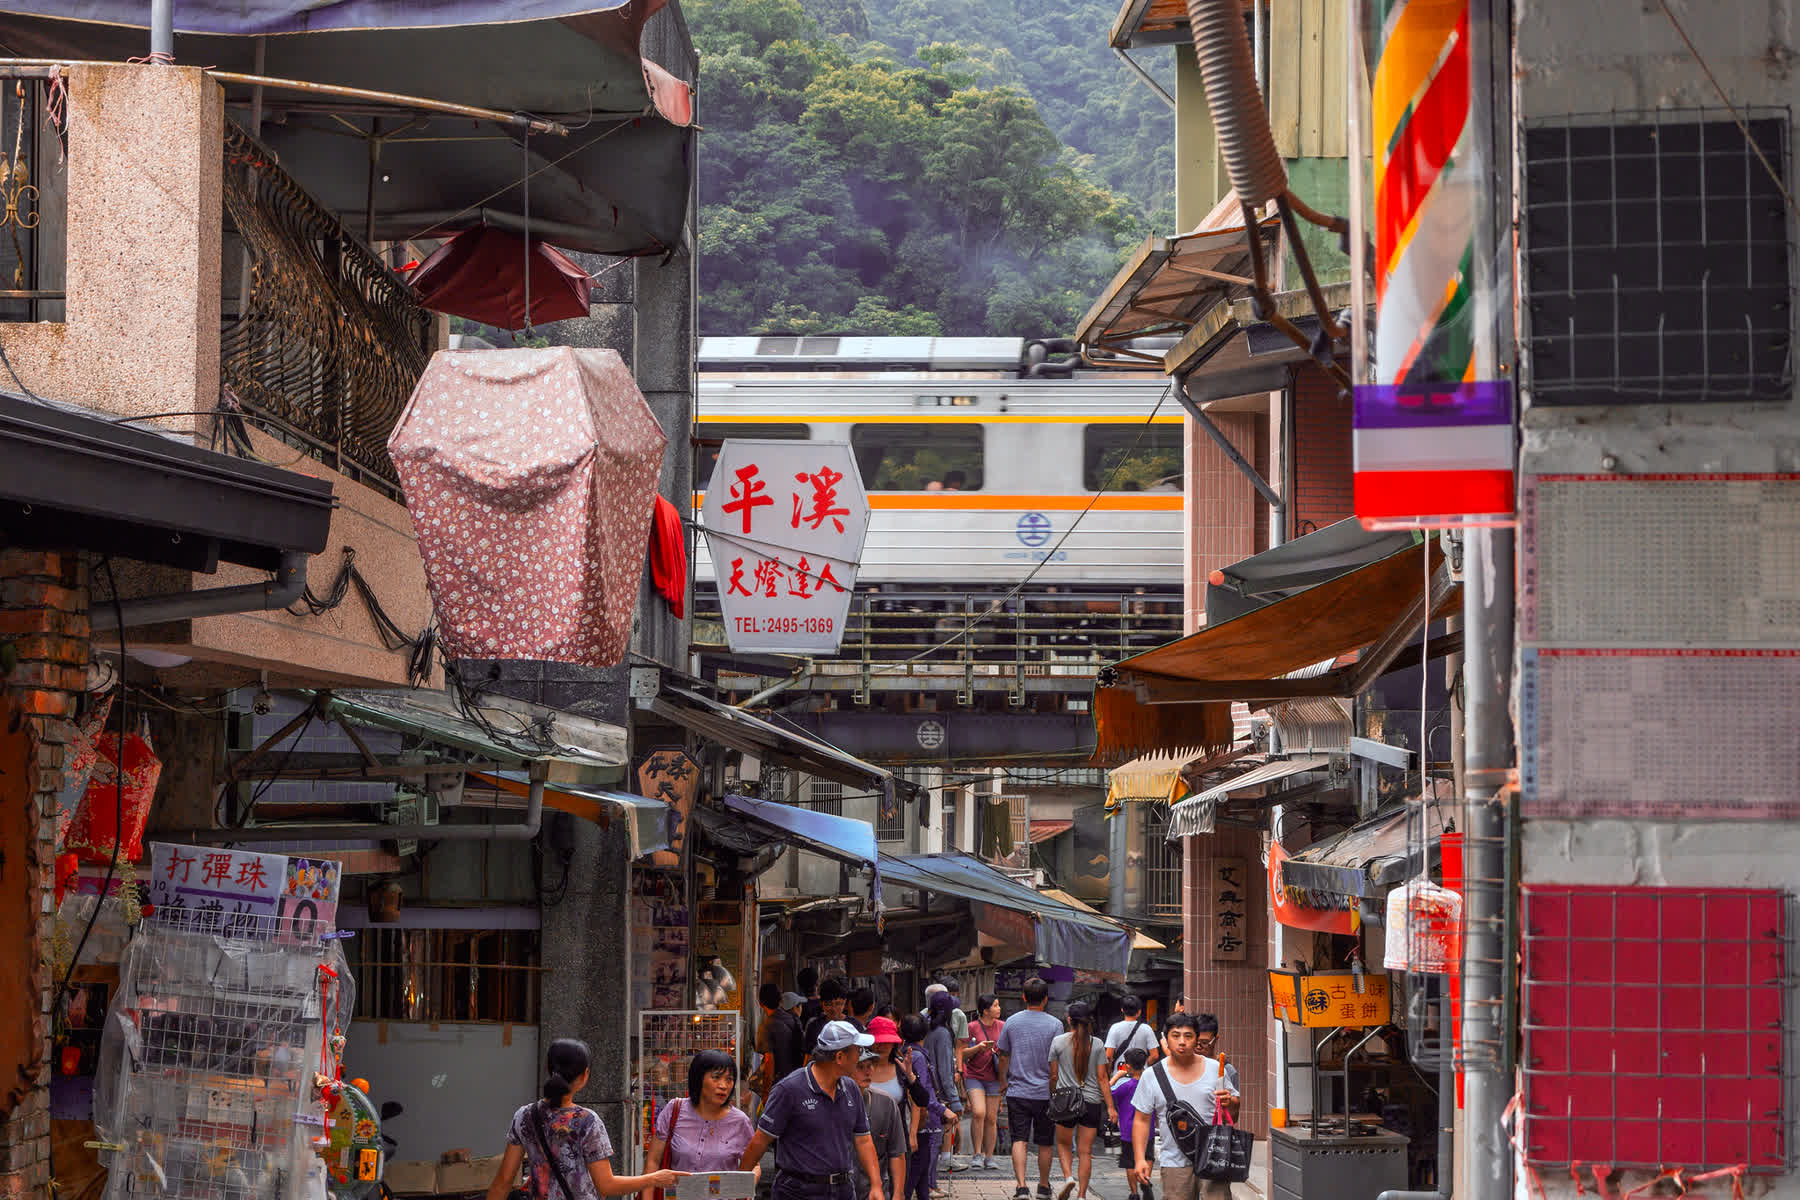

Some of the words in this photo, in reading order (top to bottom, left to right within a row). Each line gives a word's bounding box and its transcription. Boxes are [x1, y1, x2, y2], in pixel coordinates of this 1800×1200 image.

[722, 464, 850, 534] 平溪
[727, 556, 845, 600] 天燈達人
[735, 617, 834, 633] TEL:2495-1369
[153, 879, 167, 892] 10
[165, 848, 268, 893] 打彈珠
[1340, 1003, 1377, 1020] 蛋餅
